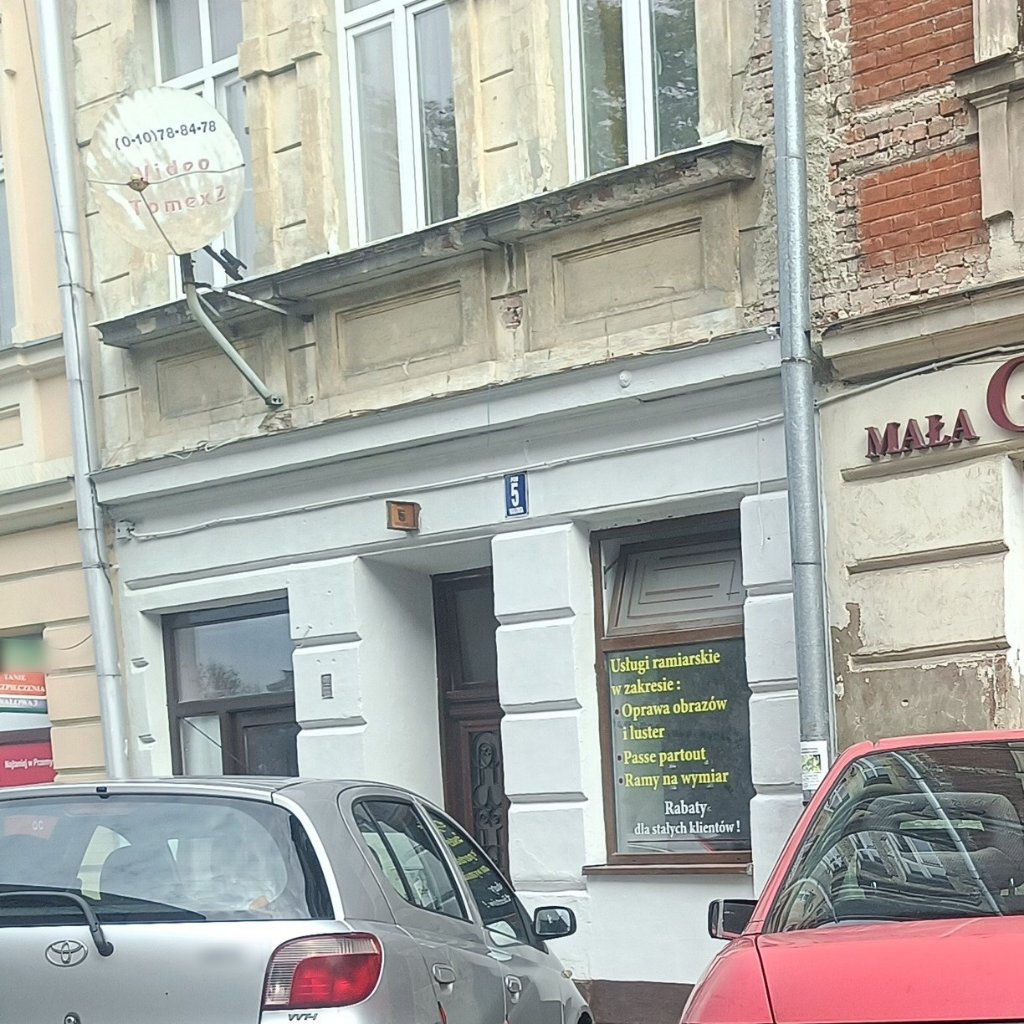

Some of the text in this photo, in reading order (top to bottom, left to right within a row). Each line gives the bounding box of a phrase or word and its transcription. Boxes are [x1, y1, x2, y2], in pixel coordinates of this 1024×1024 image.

[864, 408, 980, 460] MAŁA
[510, 481, 520, 507] 5
[610, 649, 721, 674] Usługi ramiarskie
[611, 685, 622, 695] w
[624, 677, 674, 695] zakresie
[622, 695, 728, 721] Oprawa obrazów
[622, 725, 665, 740] i luster
[624, 747, 706, 766] Passe partout
[625, 769, 729, 790] Ramy na wymiar
[665, 800, 708, 817] Rabaty
[634, 822, 650, 835] dla
[651, 821, 687, 837] stałych
